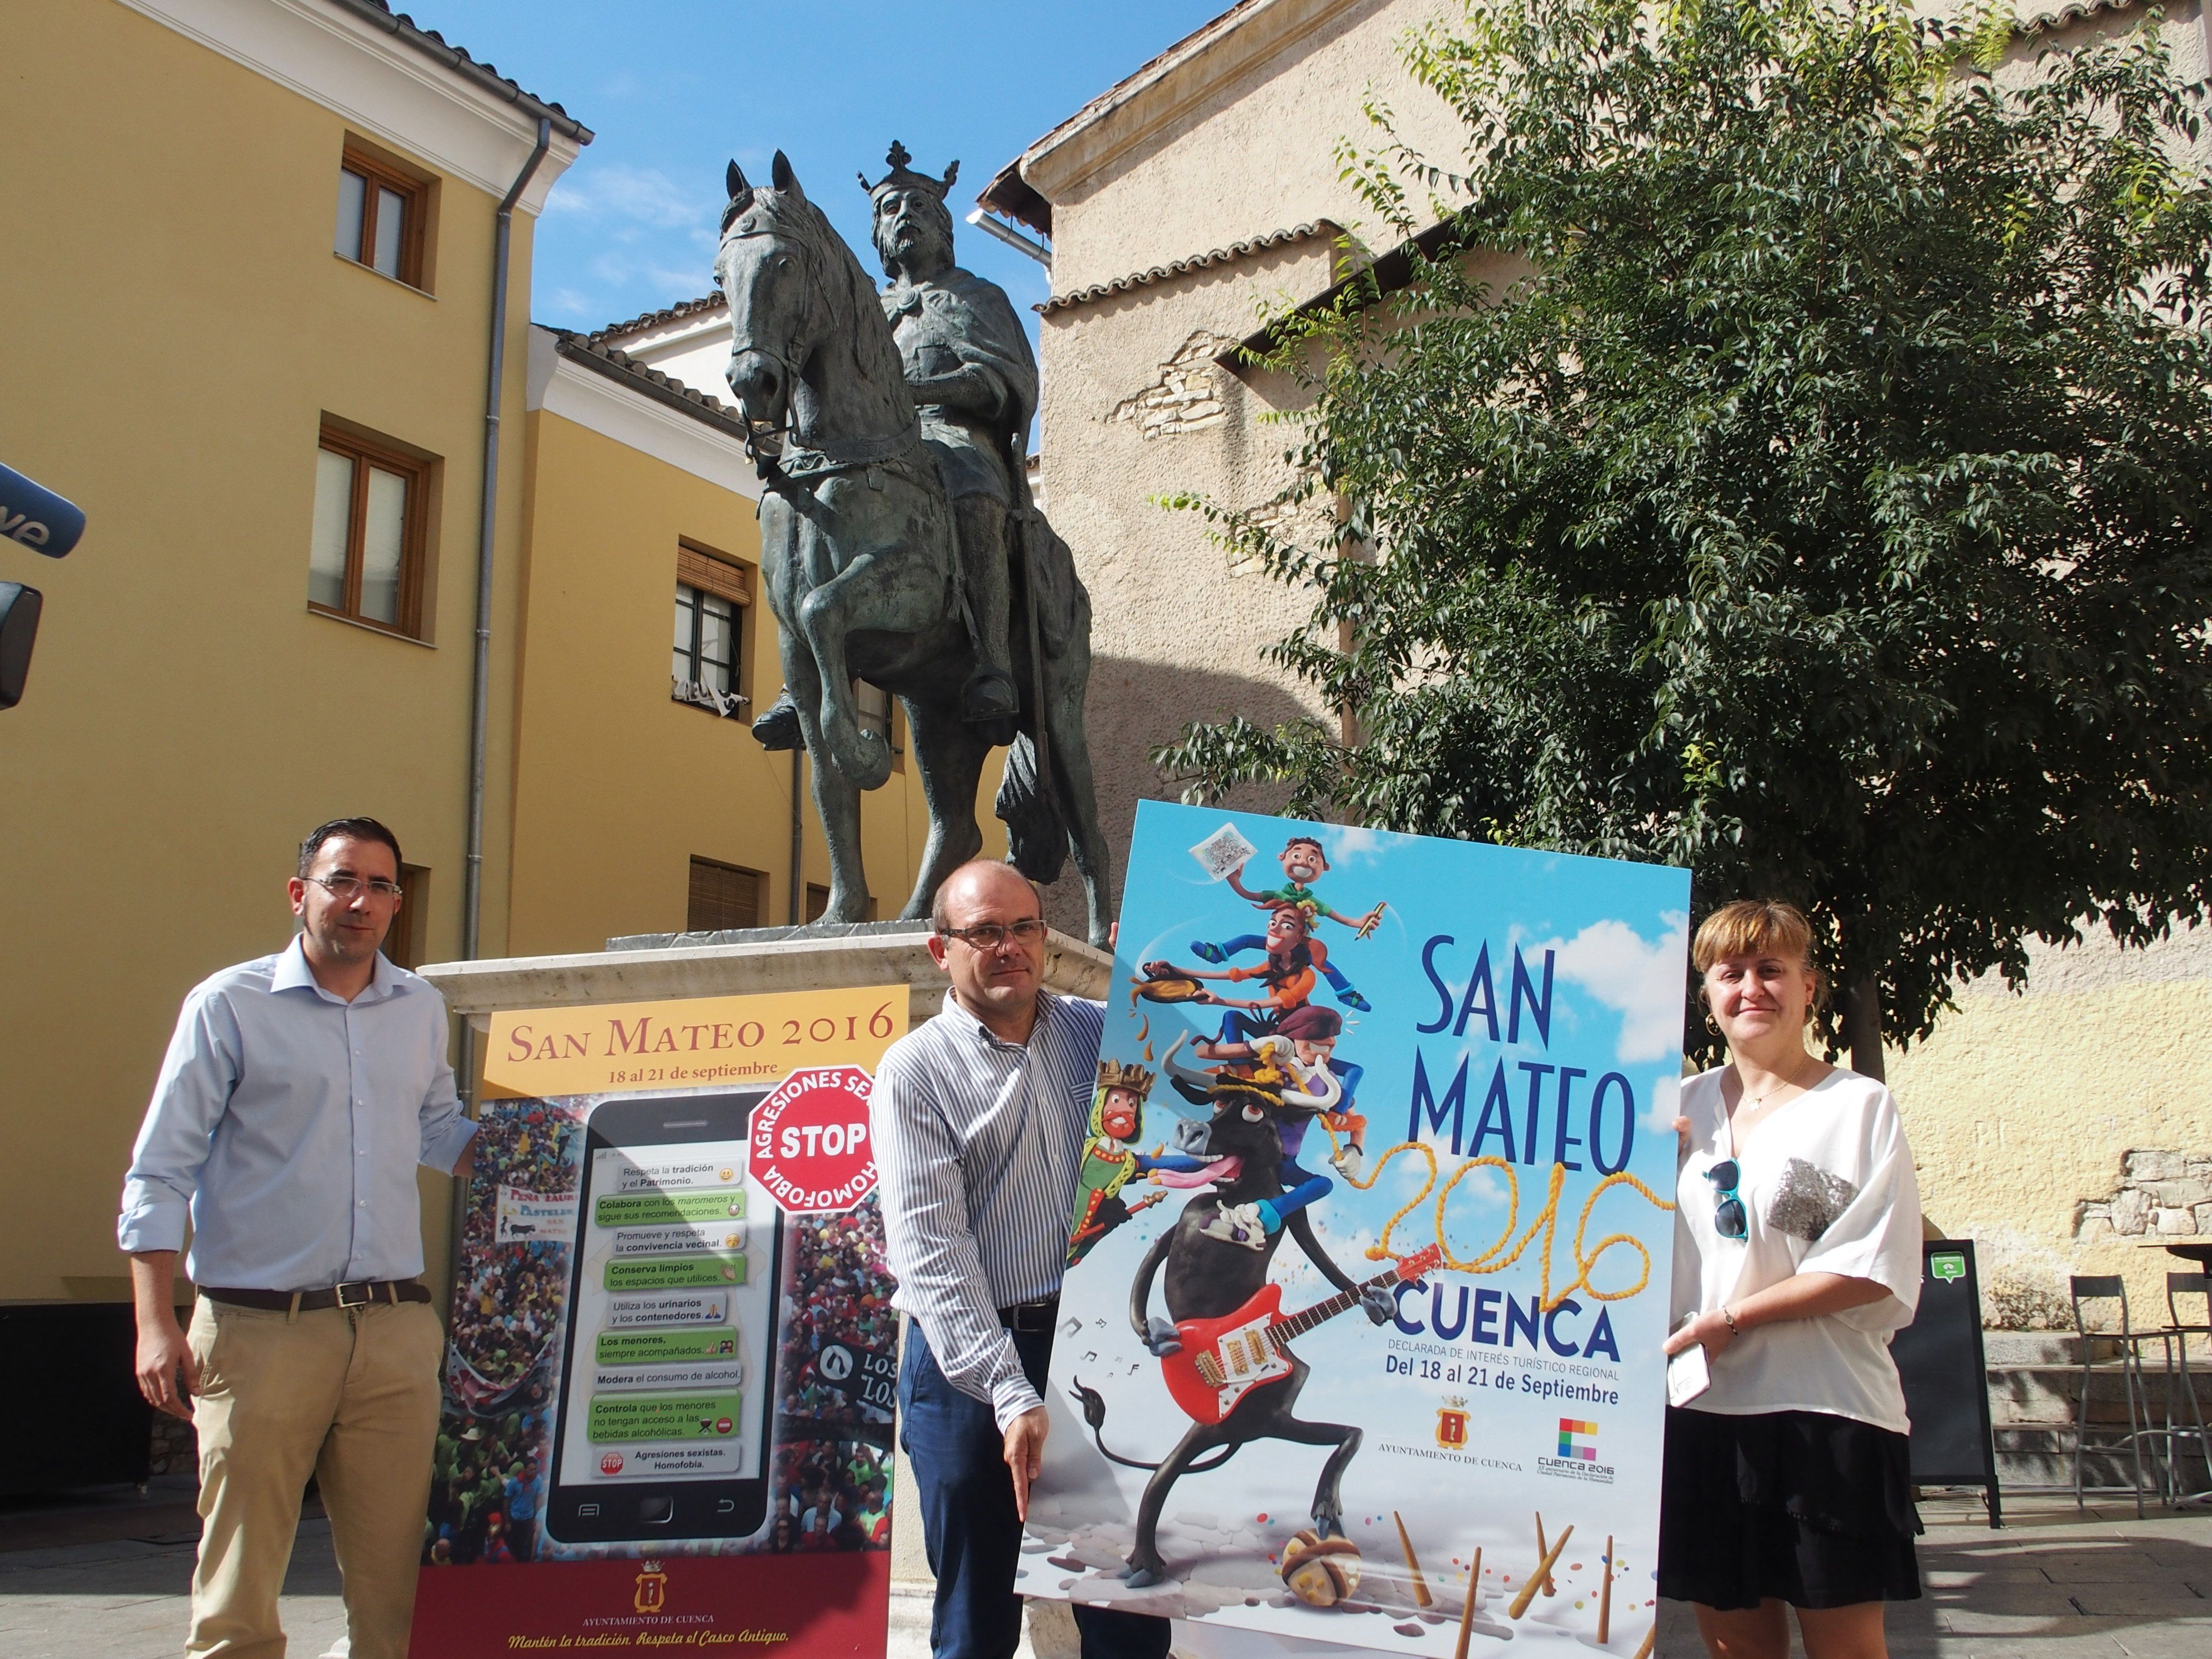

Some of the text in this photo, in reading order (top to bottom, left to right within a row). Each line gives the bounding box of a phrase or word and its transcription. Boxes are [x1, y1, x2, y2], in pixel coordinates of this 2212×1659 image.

[1417, 934, 1555, 1051] SAN
[782, 1001, 894, 1046] 2016
[609, 1061, 778, 1084] 18 al 21 de septiembre
[755, 1071, 842, 1158] AGRESIONES
[1408, 1044, 1635, 1176] MATEO
[780, 1123, 867, 1158] STOP
[624, 1164, 714, 1177] Respeta la tradición
[622, 1181, 628, 1190] y
[641, 1177, 693, 1187] Patrimonio.
[763, 1161, 878, 1207] HOMOFOBIA
[600, 1200, 641, 1209] Colabora
[663, 1197, 675, 1206] los
[678, 1196, 727, 1205] maromeros
[730, 1195, 736, 1204] y
[598, 1212, 621, 1222] sigue
[642, 1207, 722, 1218] recomendaciones.
[1364, 1142, 1667, 1312] 2016
[618, 1231, 662, 1240] Promueve
[672, 1229, 705, 1239] respeta
[616, 1239, 722, 1252] la convivencia vecinal.
[612, 1263, 693, 1275] Conserva limpios
[610, 1273, 720, 1287] los espacios que utilices.
[614, 1299, 702, 1311] Utiliza los urinarios
[612, 1311, 704, 1324] y los contenedores.
[1393, 1278, 1621, 1362] CUENCA
[601, 1337, 666, 1346] Los menores,
[600, 1346, 704, 1359] siempre acompañados.
[1388, 1339, 1619, 1380] DECLARADA DE INTERÉS TURÍSTICO REGIONAL
[598, 1370, 740, 1384] Modera el consumo de alcohol.
[1386, 1355, 1618, 1405] Del 18 al 21 de Septiembre
[596, 1404, 637, 1414] Controla
[640, 1404, 657, 1414] que
[676, 1401, 716, 1410] menores
[609, 1417, 639, 1427] tengan
[642, 1416, 675, 1424] acceso
[686, 1414, 700, 1423] las
[593, 1427, 685, 1439] bebidas alcohólicas.
[635, 1448, 725, 1459] Agresiones sexistas.
[1379, 1443, 1522, 1472] AYUNTAMIENTO DE CUENCA
[602, 1458, 623, 1468] STOP
[654, 1461, 704, 1470] Homofobia.
[1588, 1464, 1614, 1474] 2016
[583, 1616, 658, 1627] AYUNTAMIENTO
[676, 1615, 714, 1623] CUENCA
[508, 1628, 789, 1649] Mantén la tradición. Respeta el Casco Antiguo.
